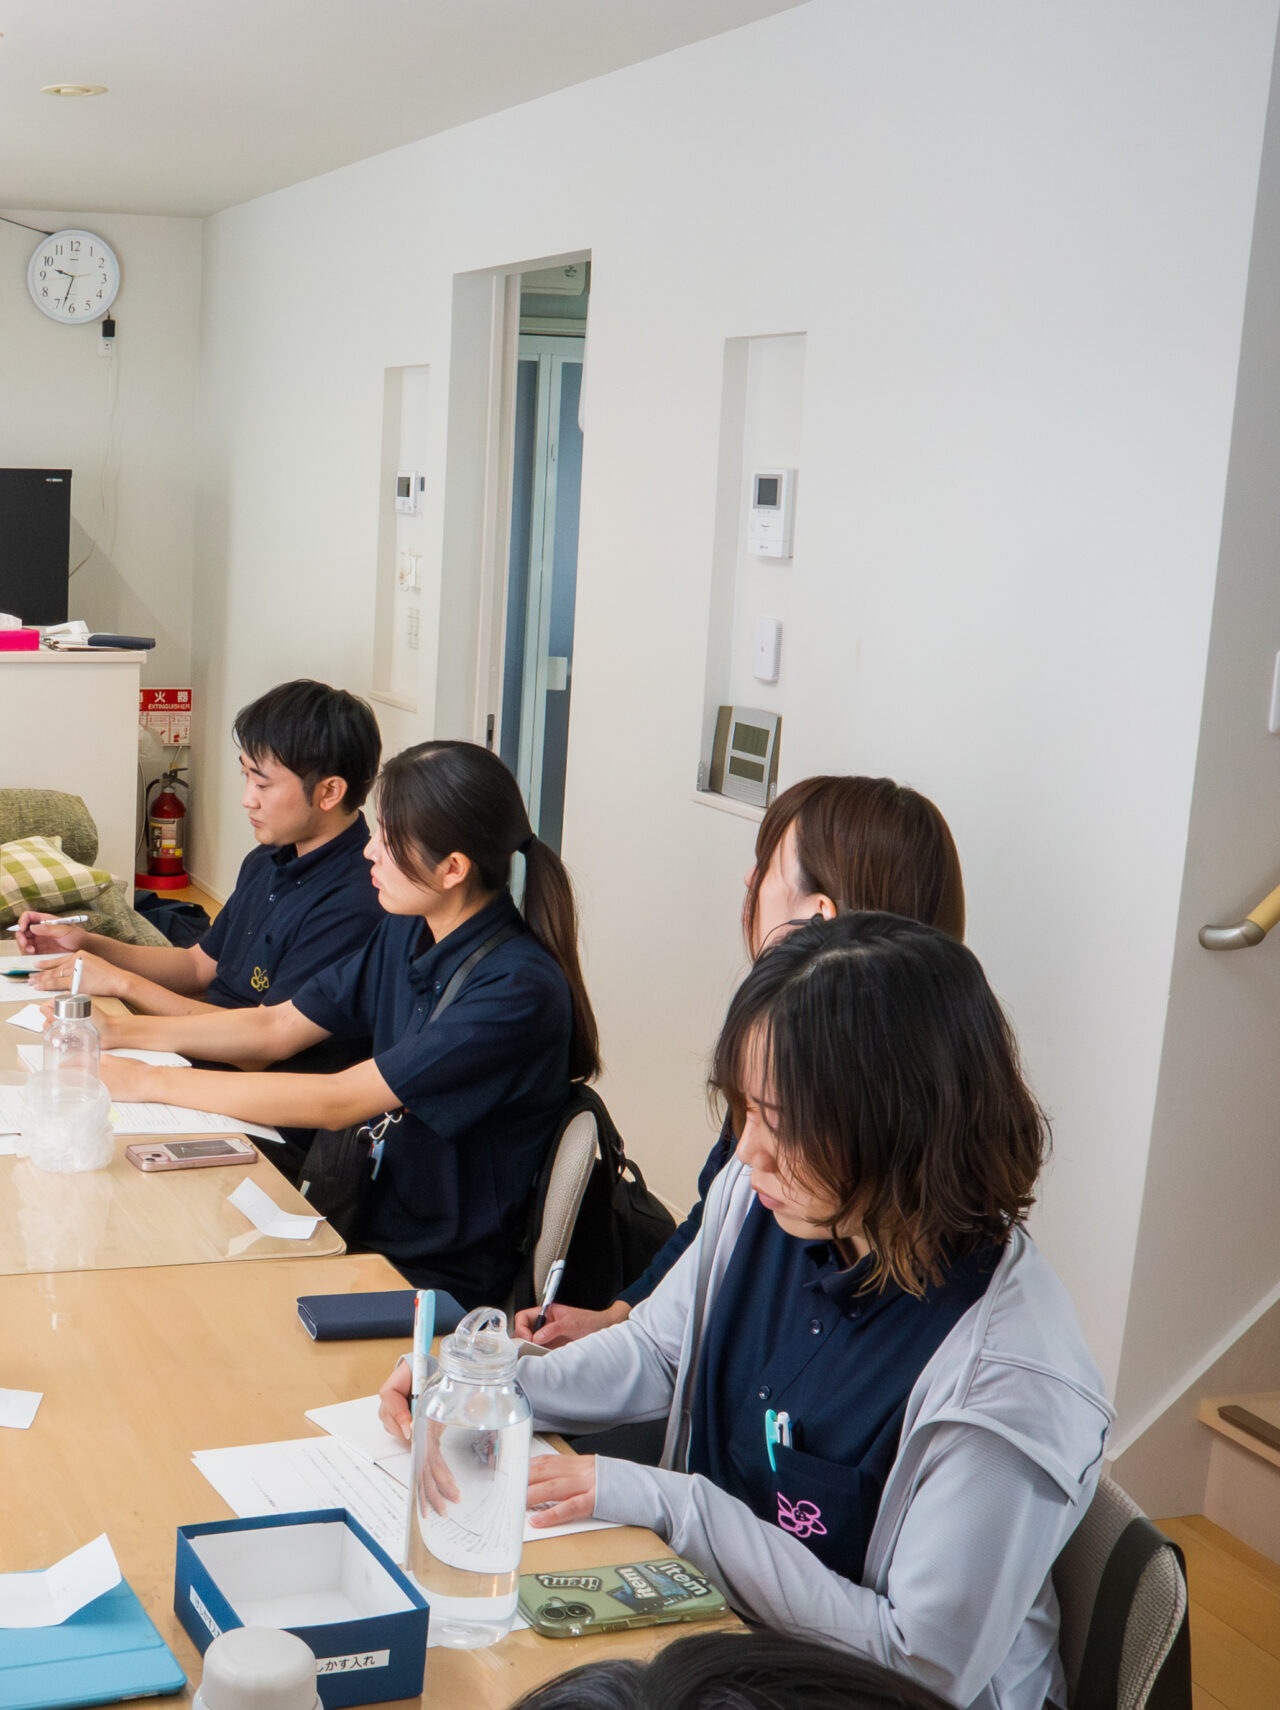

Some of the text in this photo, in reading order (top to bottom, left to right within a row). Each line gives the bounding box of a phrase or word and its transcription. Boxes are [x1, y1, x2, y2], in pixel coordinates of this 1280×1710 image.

[55, 244, 63, 255] 11
[70, 240, 81, 252] 12
[44, 255, 54, 267] 10
[98, 257, 105, 269] 2
[39, 270, 47, 281] 9
[100, 273, 107, 284] 3
[42, 287, 49, 297] 8
[95, 289, 103, 299] 4
[54, 298, 61, 309] 7
[68, 303, 76, 314] 6
[84, 300, 91, 311] 5
[140, 691, 189, 703] 火器
